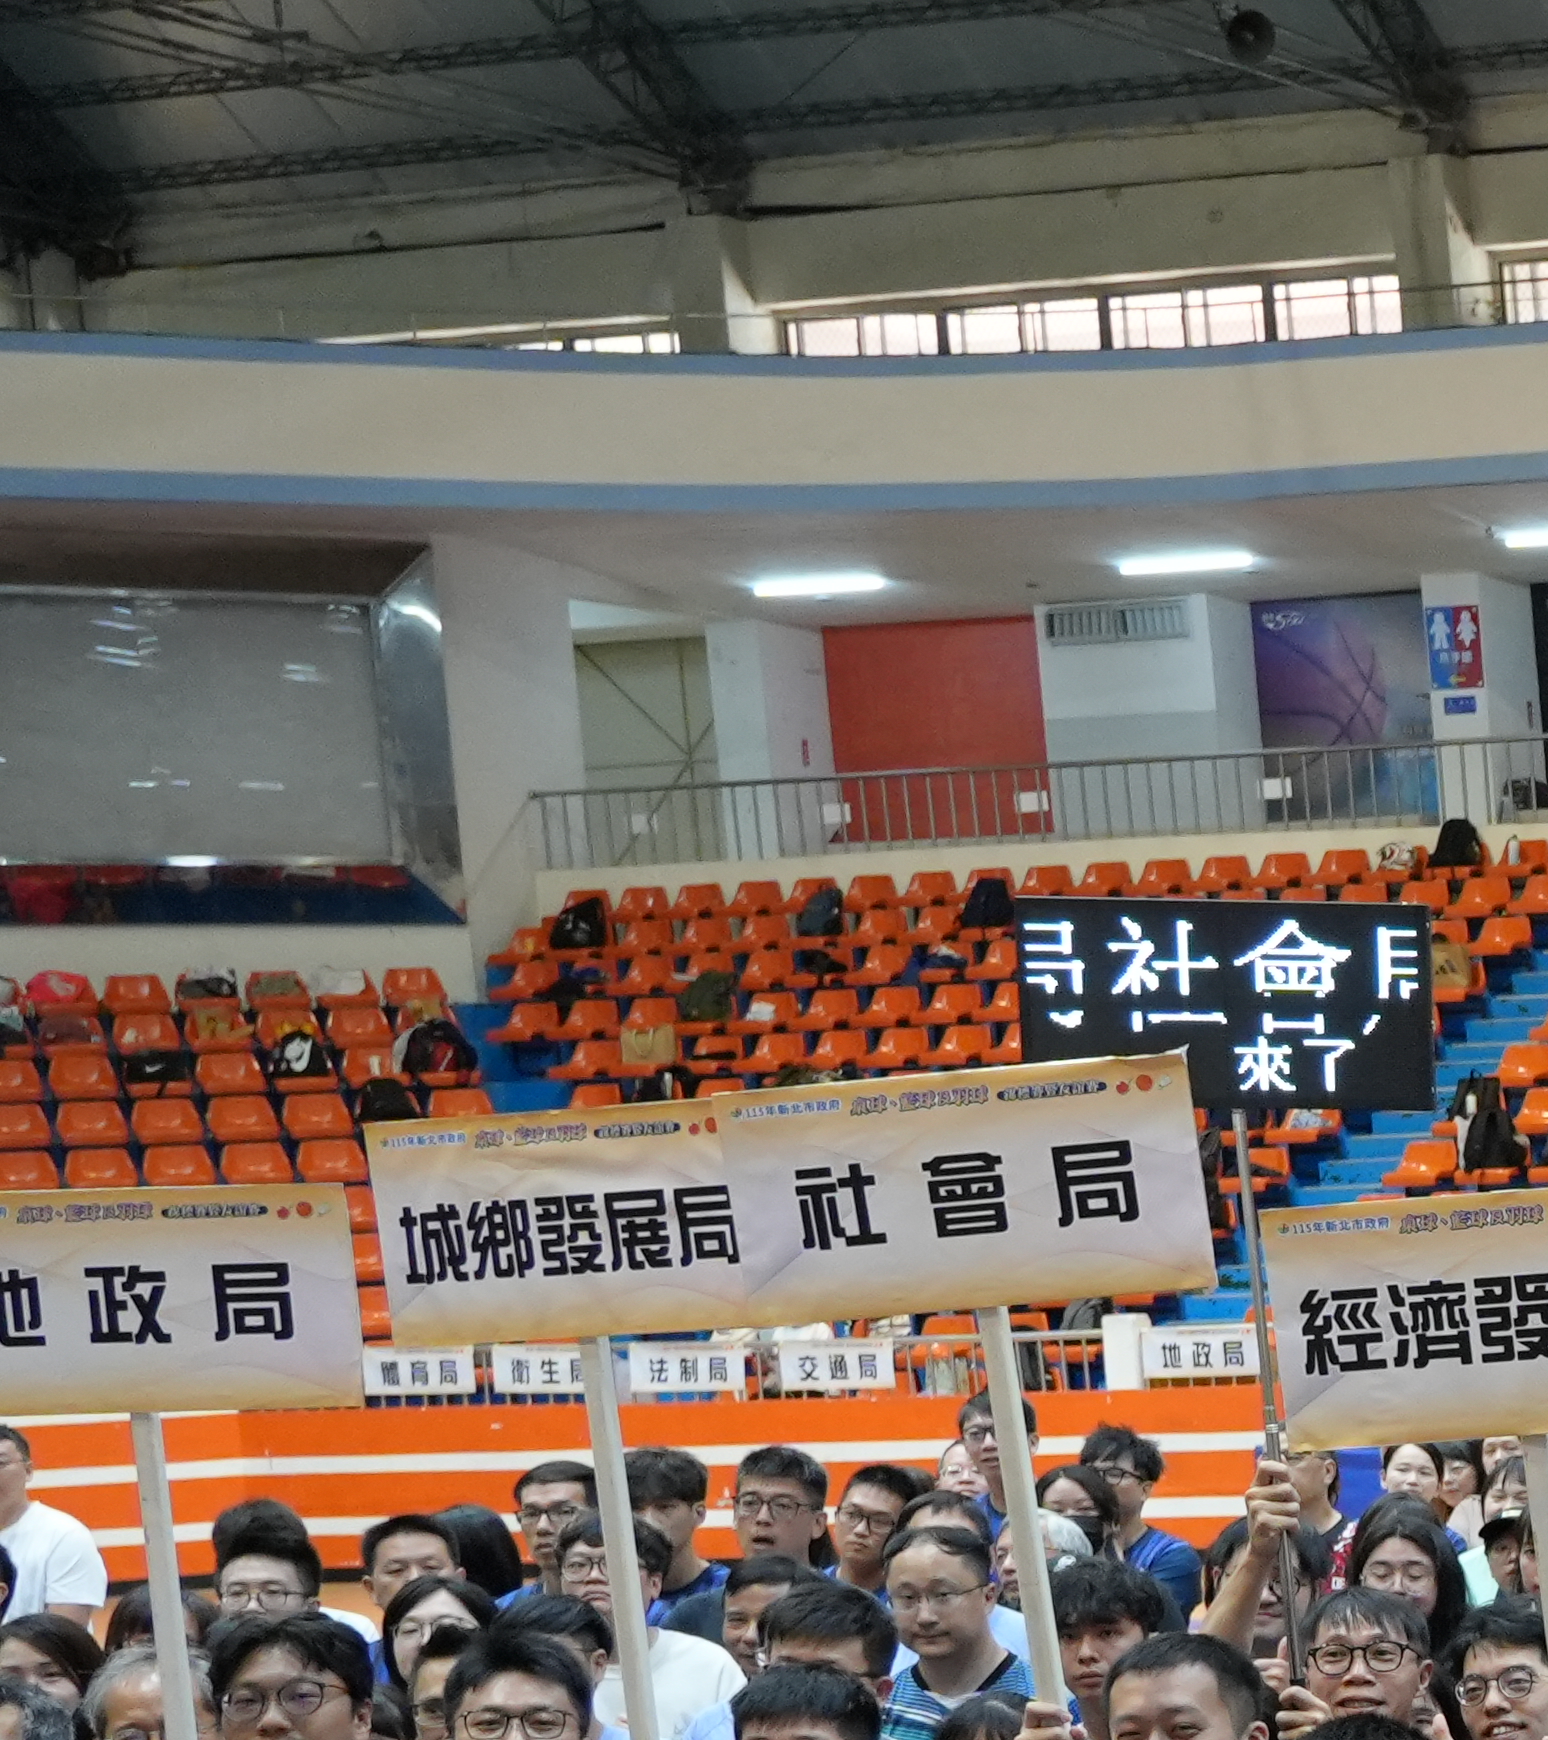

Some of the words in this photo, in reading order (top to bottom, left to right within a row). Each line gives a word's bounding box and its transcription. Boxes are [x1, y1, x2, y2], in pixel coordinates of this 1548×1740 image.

[1234, 1036, 1357, 1093] 來了
[795, 1140, 1140, 1251] 社會局
[400, 1184, 741, 1286] 城鄉發展局
[799, 1354, 877, 1382] 交通局
[1162, 1341, 1244, 1369] 地政局
[380, 1360, 458, 1386] 體育局
[649, 1357, 729, 1384] 法制局
